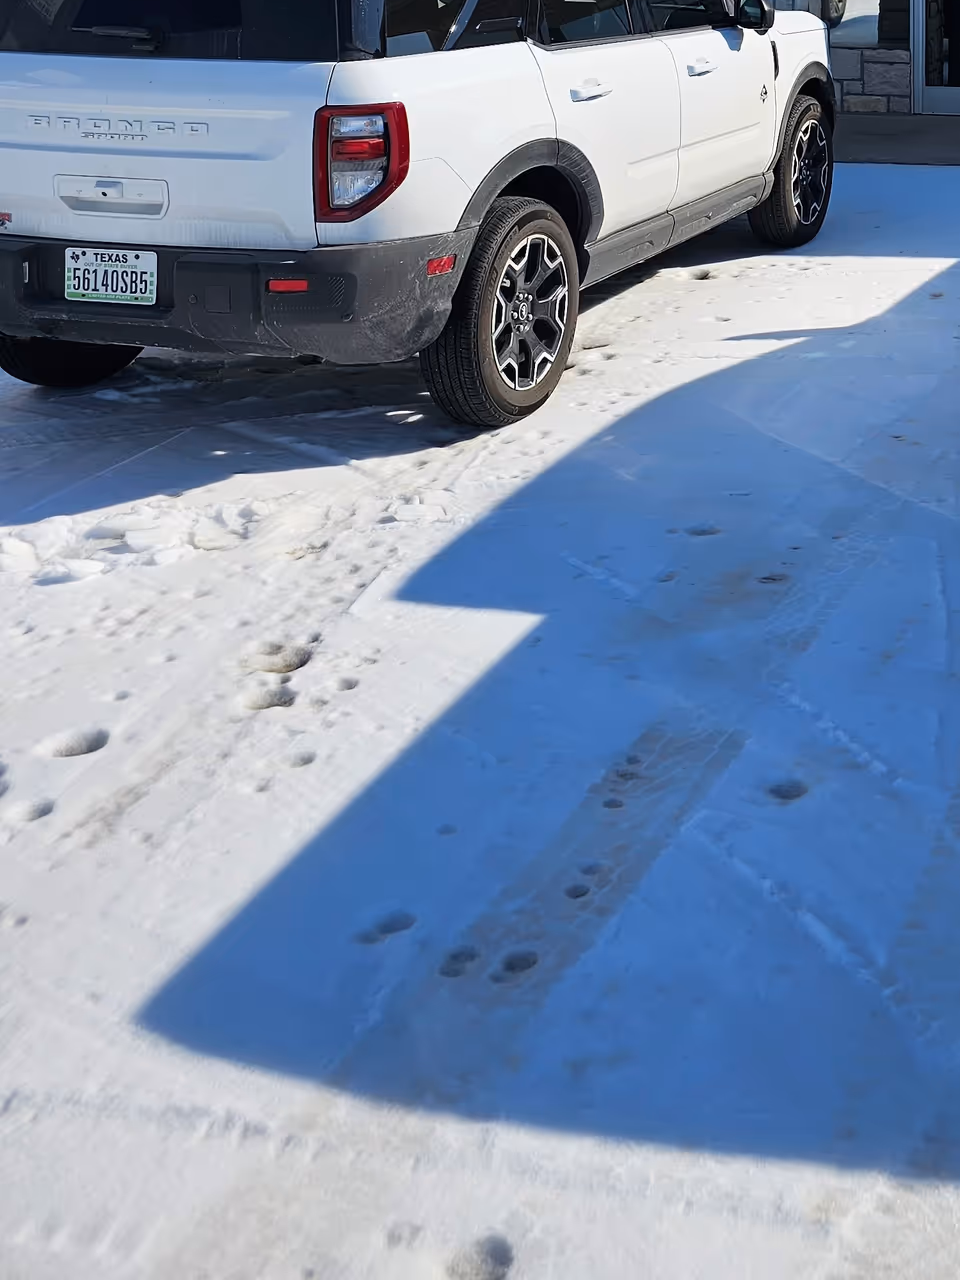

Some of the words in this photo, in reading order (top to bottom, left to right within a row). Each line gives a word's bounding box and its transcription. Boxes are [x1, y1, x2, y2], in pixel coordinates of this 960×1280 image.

[27, 114, 210, 136] BRONCO
[80, 131, 148, 141] SPORT
[93, 253, 128, 263] TEXAS
[73, 268, 148, 294] 56140SB5
